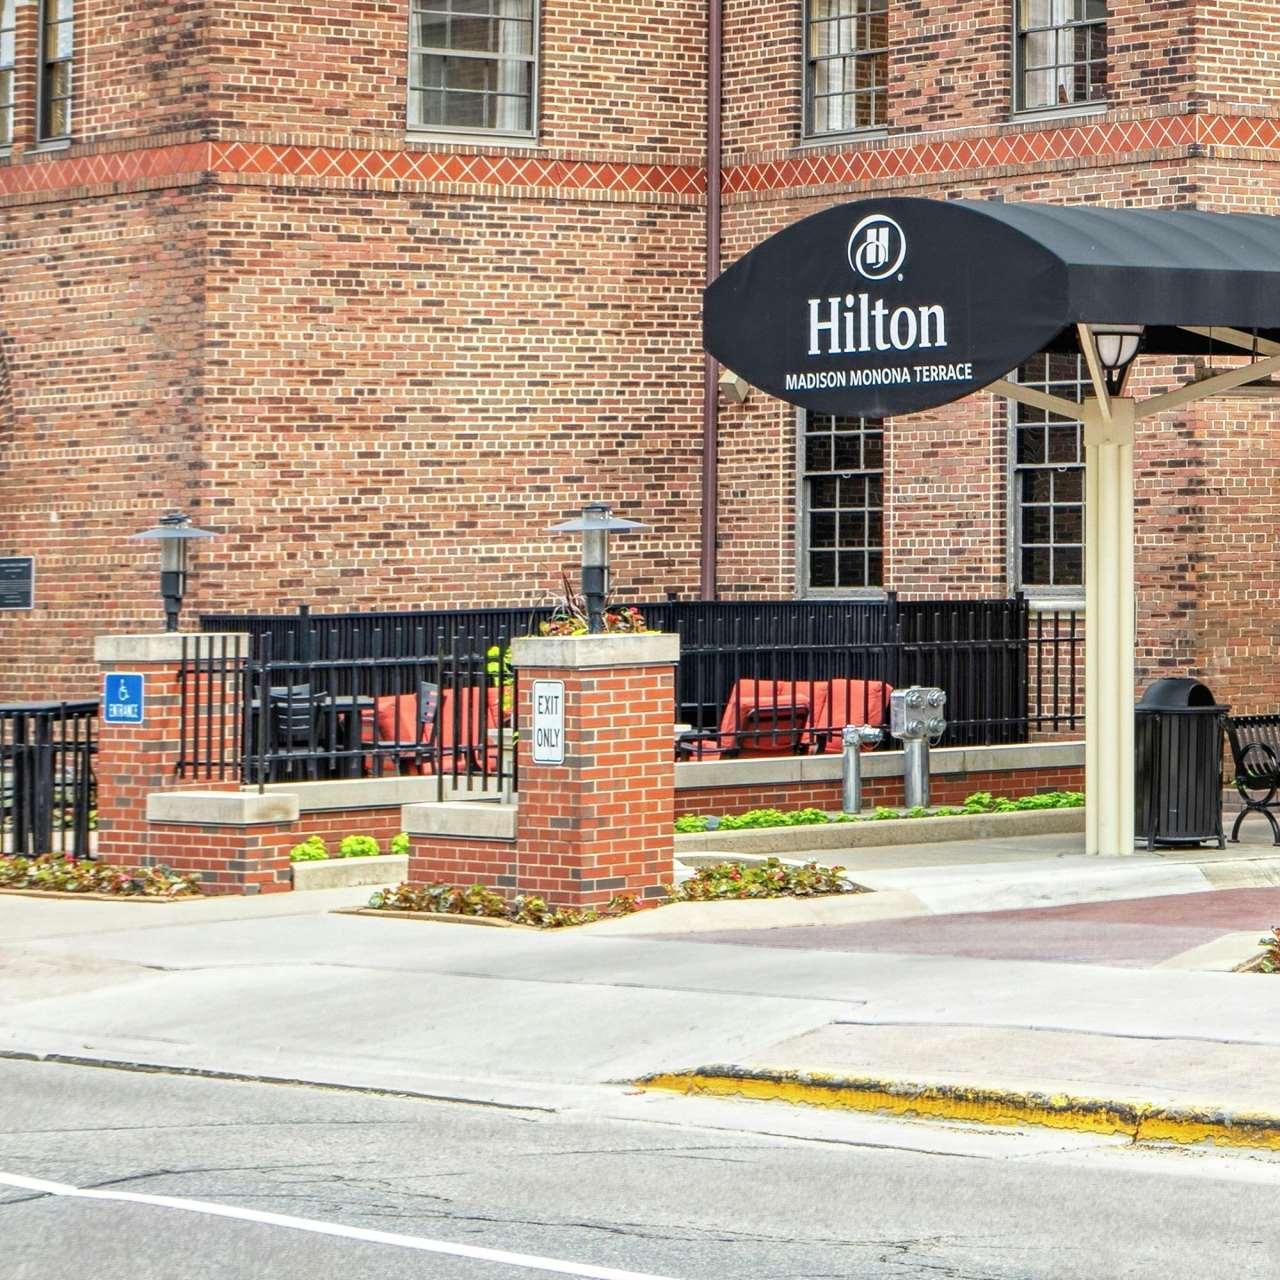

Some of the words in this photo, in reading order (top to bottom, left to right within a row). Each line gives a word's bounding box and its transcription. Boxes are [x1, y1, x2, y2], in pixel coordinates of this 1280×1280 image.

[807, 293, 948, 356] Hilton
[785, 370, 847, 391] MADISON
[848, 366, 911, 388] MONONA
[913, 363, 973, 382] TERRACE
[537, 695, 560, 715] EXIT
[536, 727, 561, 748] ONLY
